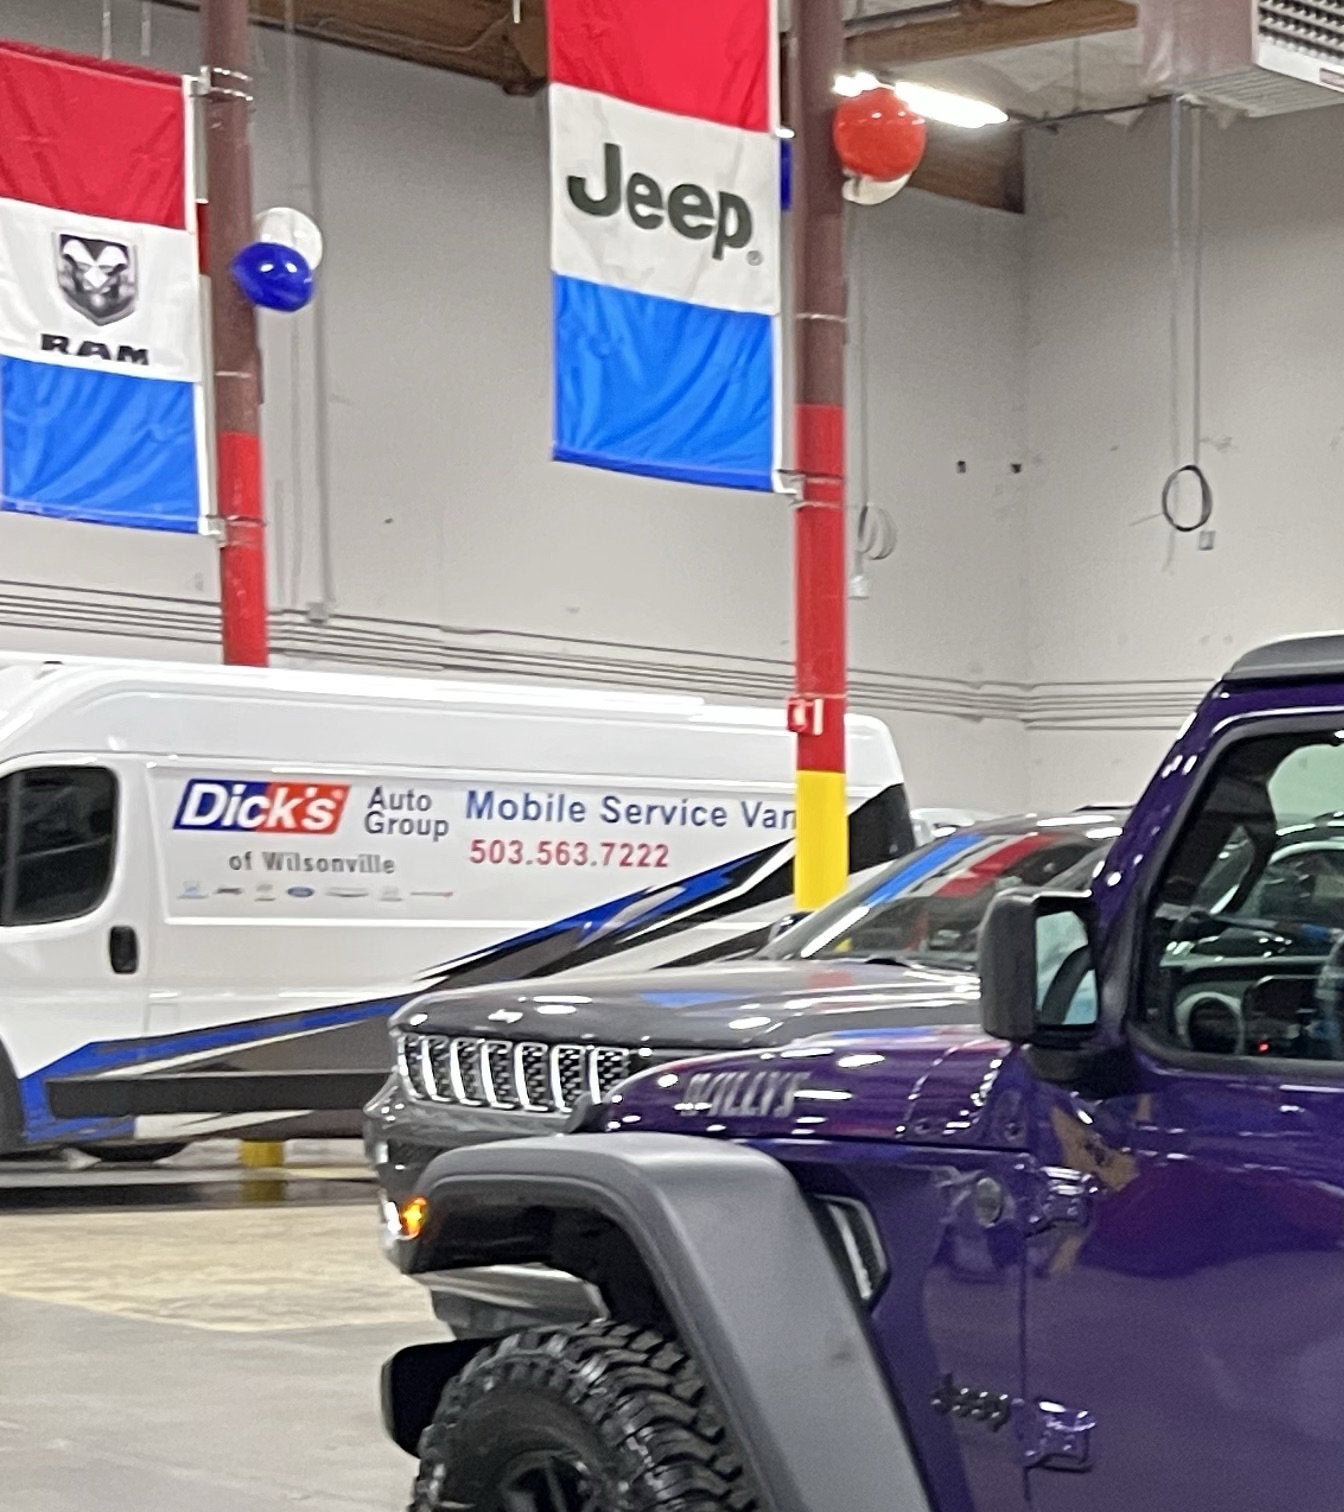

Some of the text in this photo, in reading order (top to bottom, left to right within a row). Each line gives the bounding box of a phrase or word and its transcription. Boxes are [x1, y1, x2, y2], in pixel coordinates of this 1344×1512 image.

[566, 142, 753, 261] Jeep
[41, 333, 149, 366] RAM
[180, 783, 338, 831] Dick's
[367, 786, 432, 812] Auto
[465, 790, 586, 823] Mobile
[600, 795, 728, 827] Service
[364, 811, 449, 841] Group
[229, 851, 396, 874] of Wilsonville
[469, 839, 670, 868] 503.563.7222
